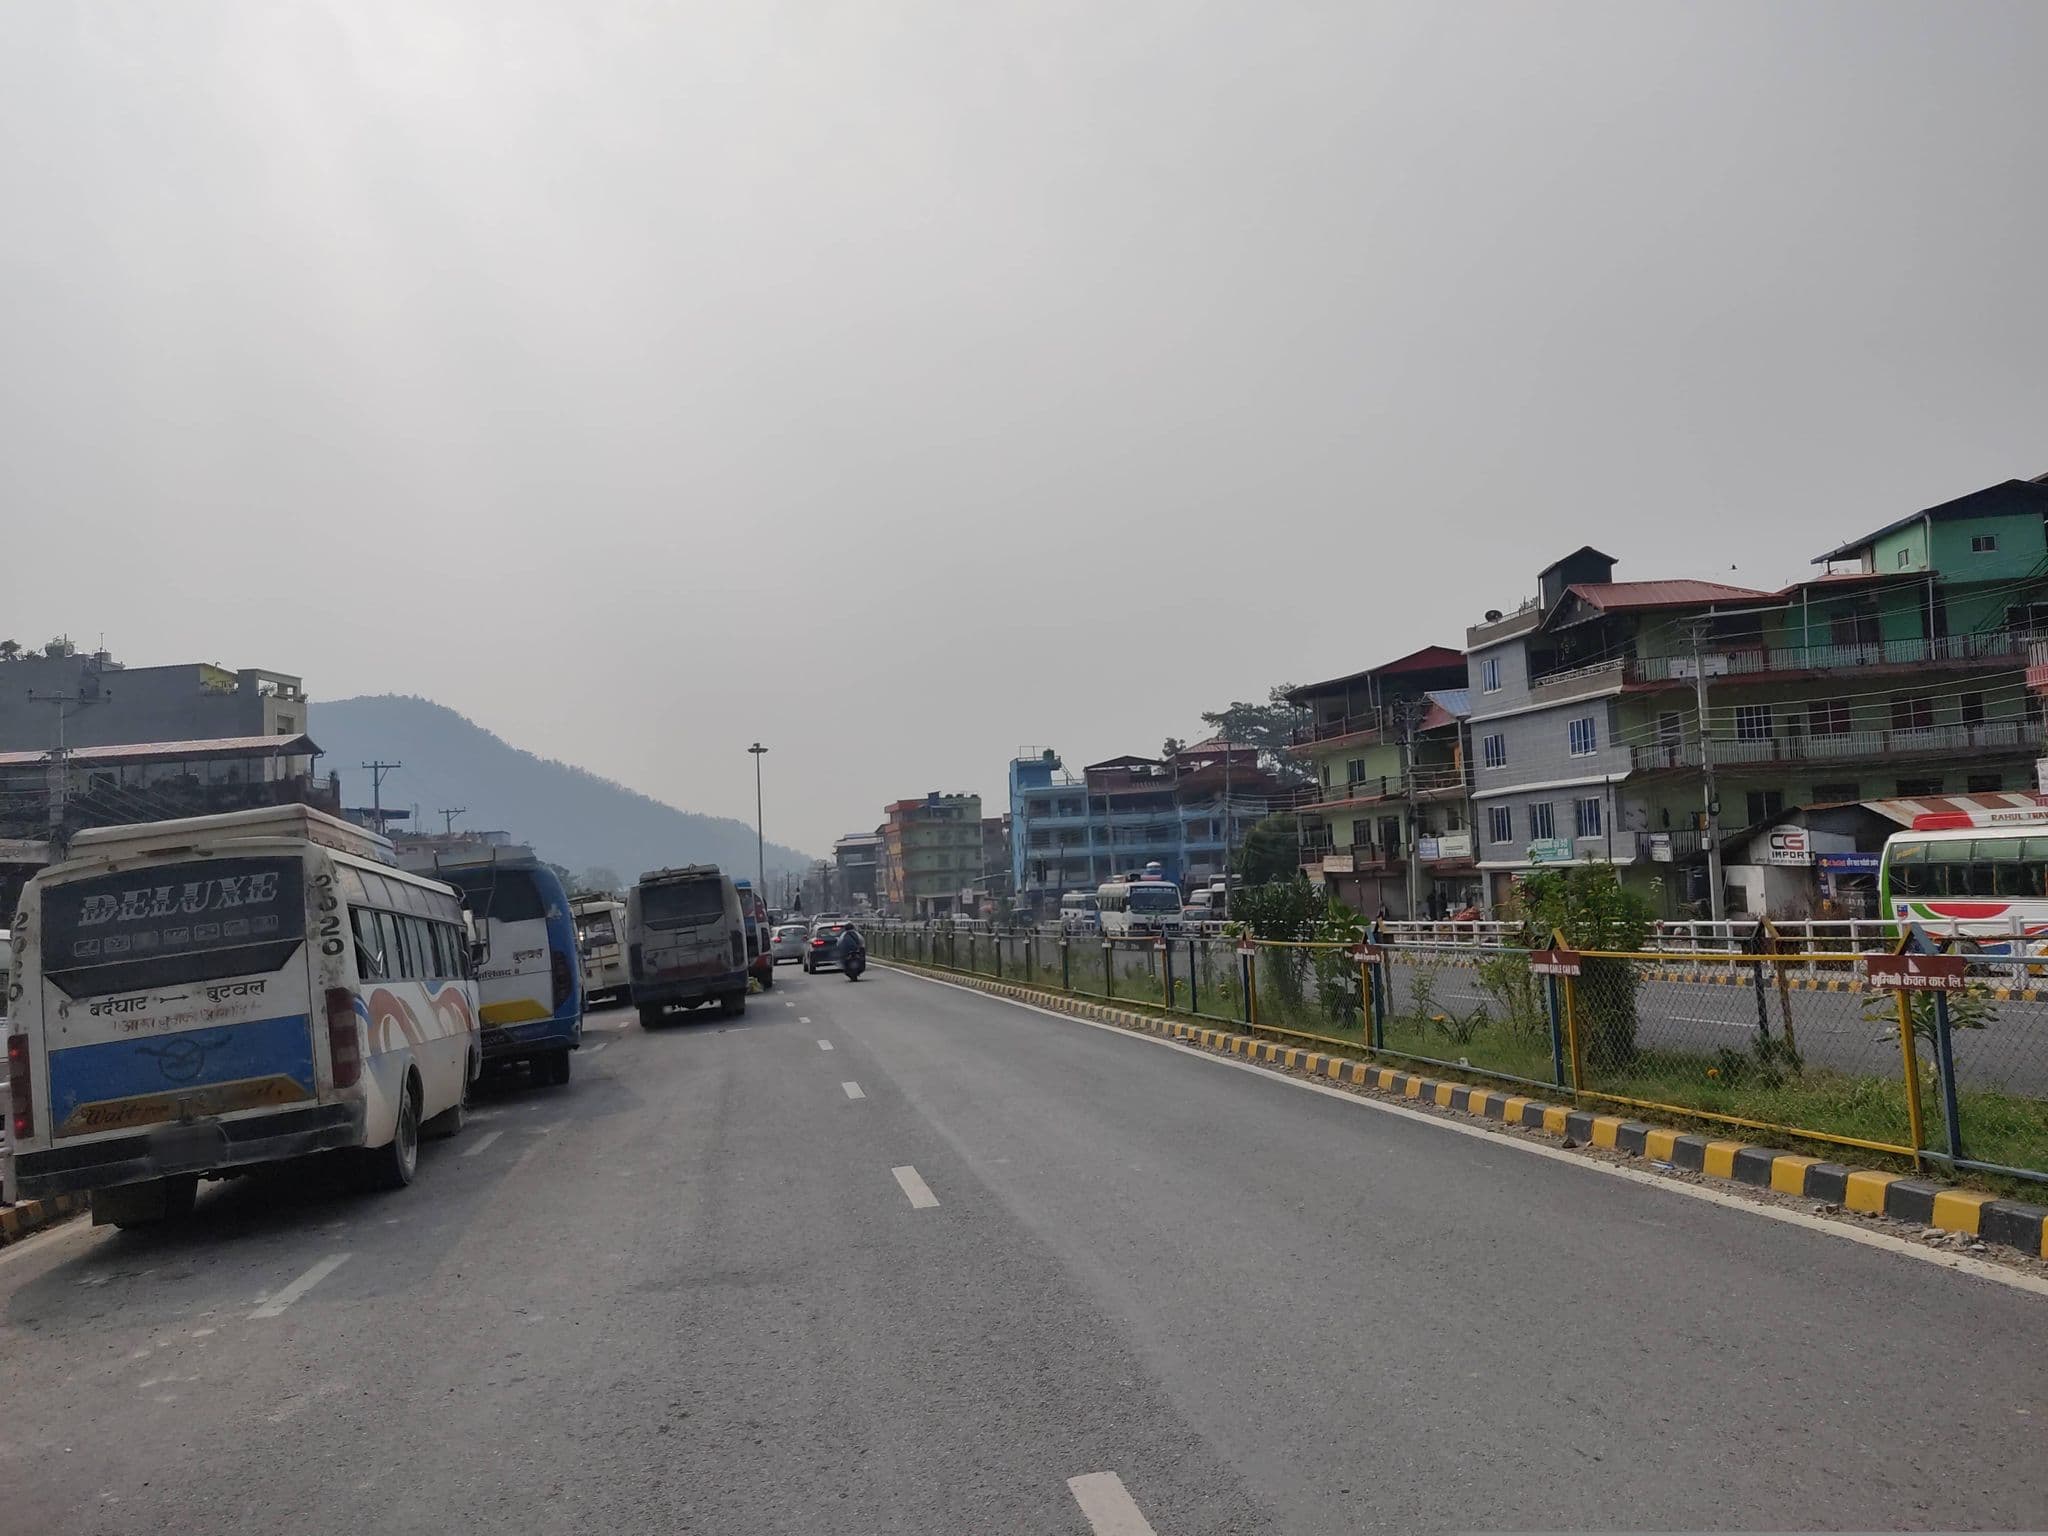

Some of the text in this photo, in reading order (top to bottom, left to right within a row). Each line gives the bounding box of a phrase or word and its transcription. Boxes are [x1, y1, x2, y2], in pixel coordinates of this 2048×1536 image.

[1991, 813, 2023, 821] RAHUL
[78, 872, 279, 927] DELUXE
[1903, 973, 1926, 986] केवल
[1928, 975, 1946, 988] कार
[89, 996, 149, 1017] बर्दघाट
[206, 979, 267, 1003] बुटवल
